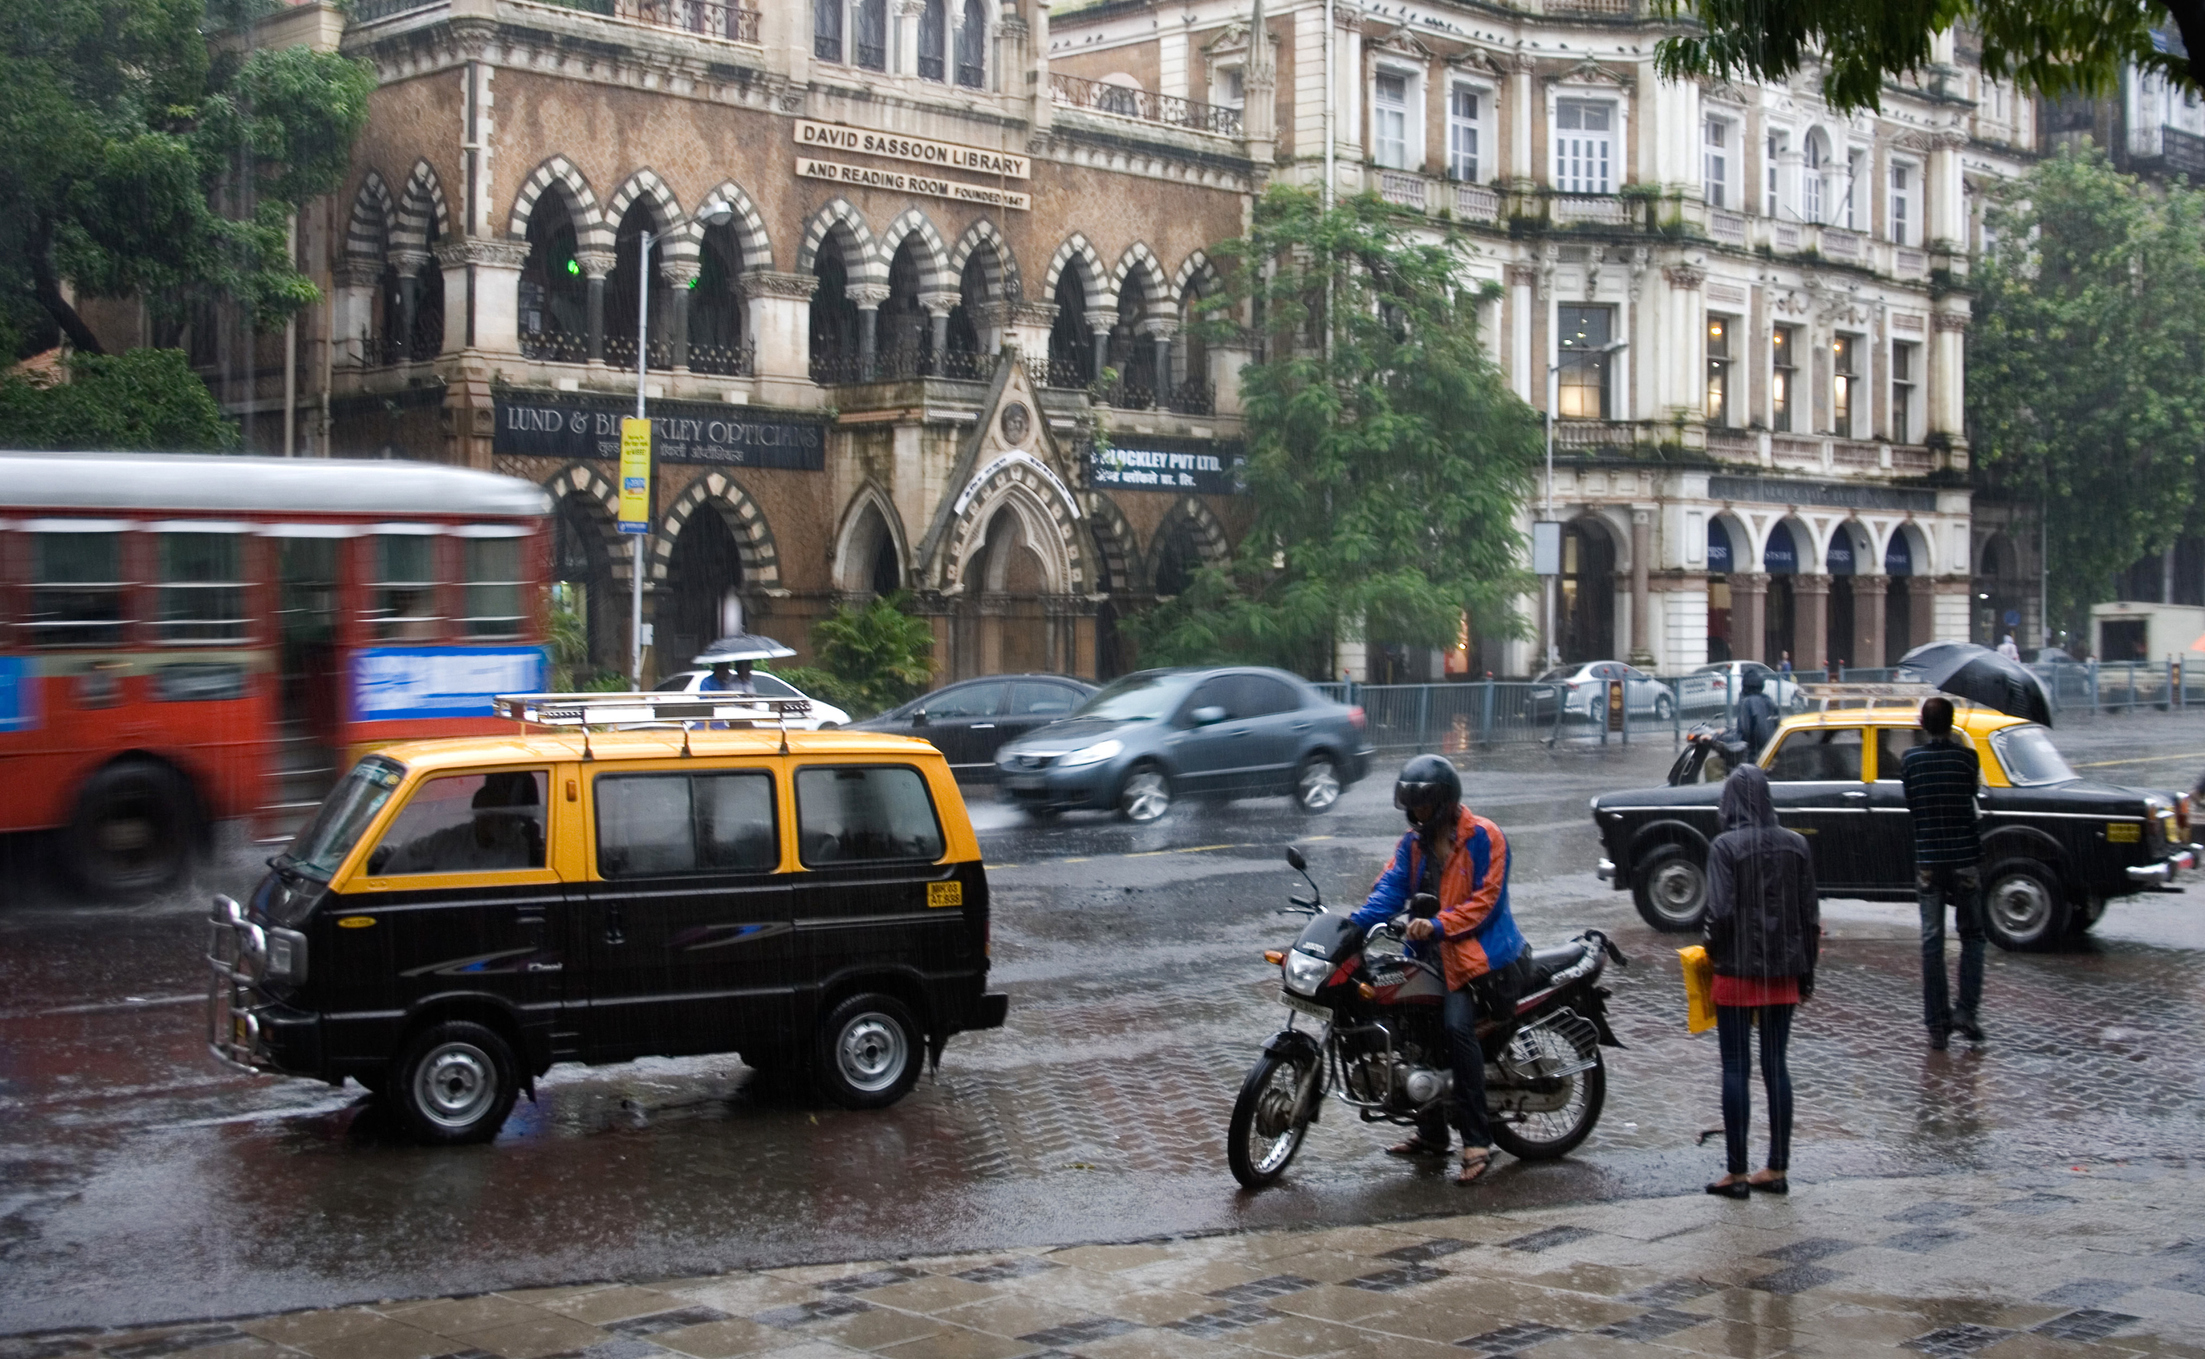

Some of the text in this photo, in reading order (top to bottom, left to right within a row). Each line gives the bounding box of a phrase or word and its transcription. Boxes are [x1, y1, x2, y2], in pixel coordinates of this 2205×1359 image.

[804, 125, 1024, 174] DAVID SASSOON LIBRARY
[807, 162, 837, 178] AND
[841, 167, 904, 189] READING
[909, 177, 949, 195] ROOM
[955, 187, 1001, 203] FOUNDED
[507, 407, 818, 448] LUND & BLKLEY OPTICIANS
[1169, 453, 1195, 470] PVT
[1197, 455, 1222, 471] LTD.
